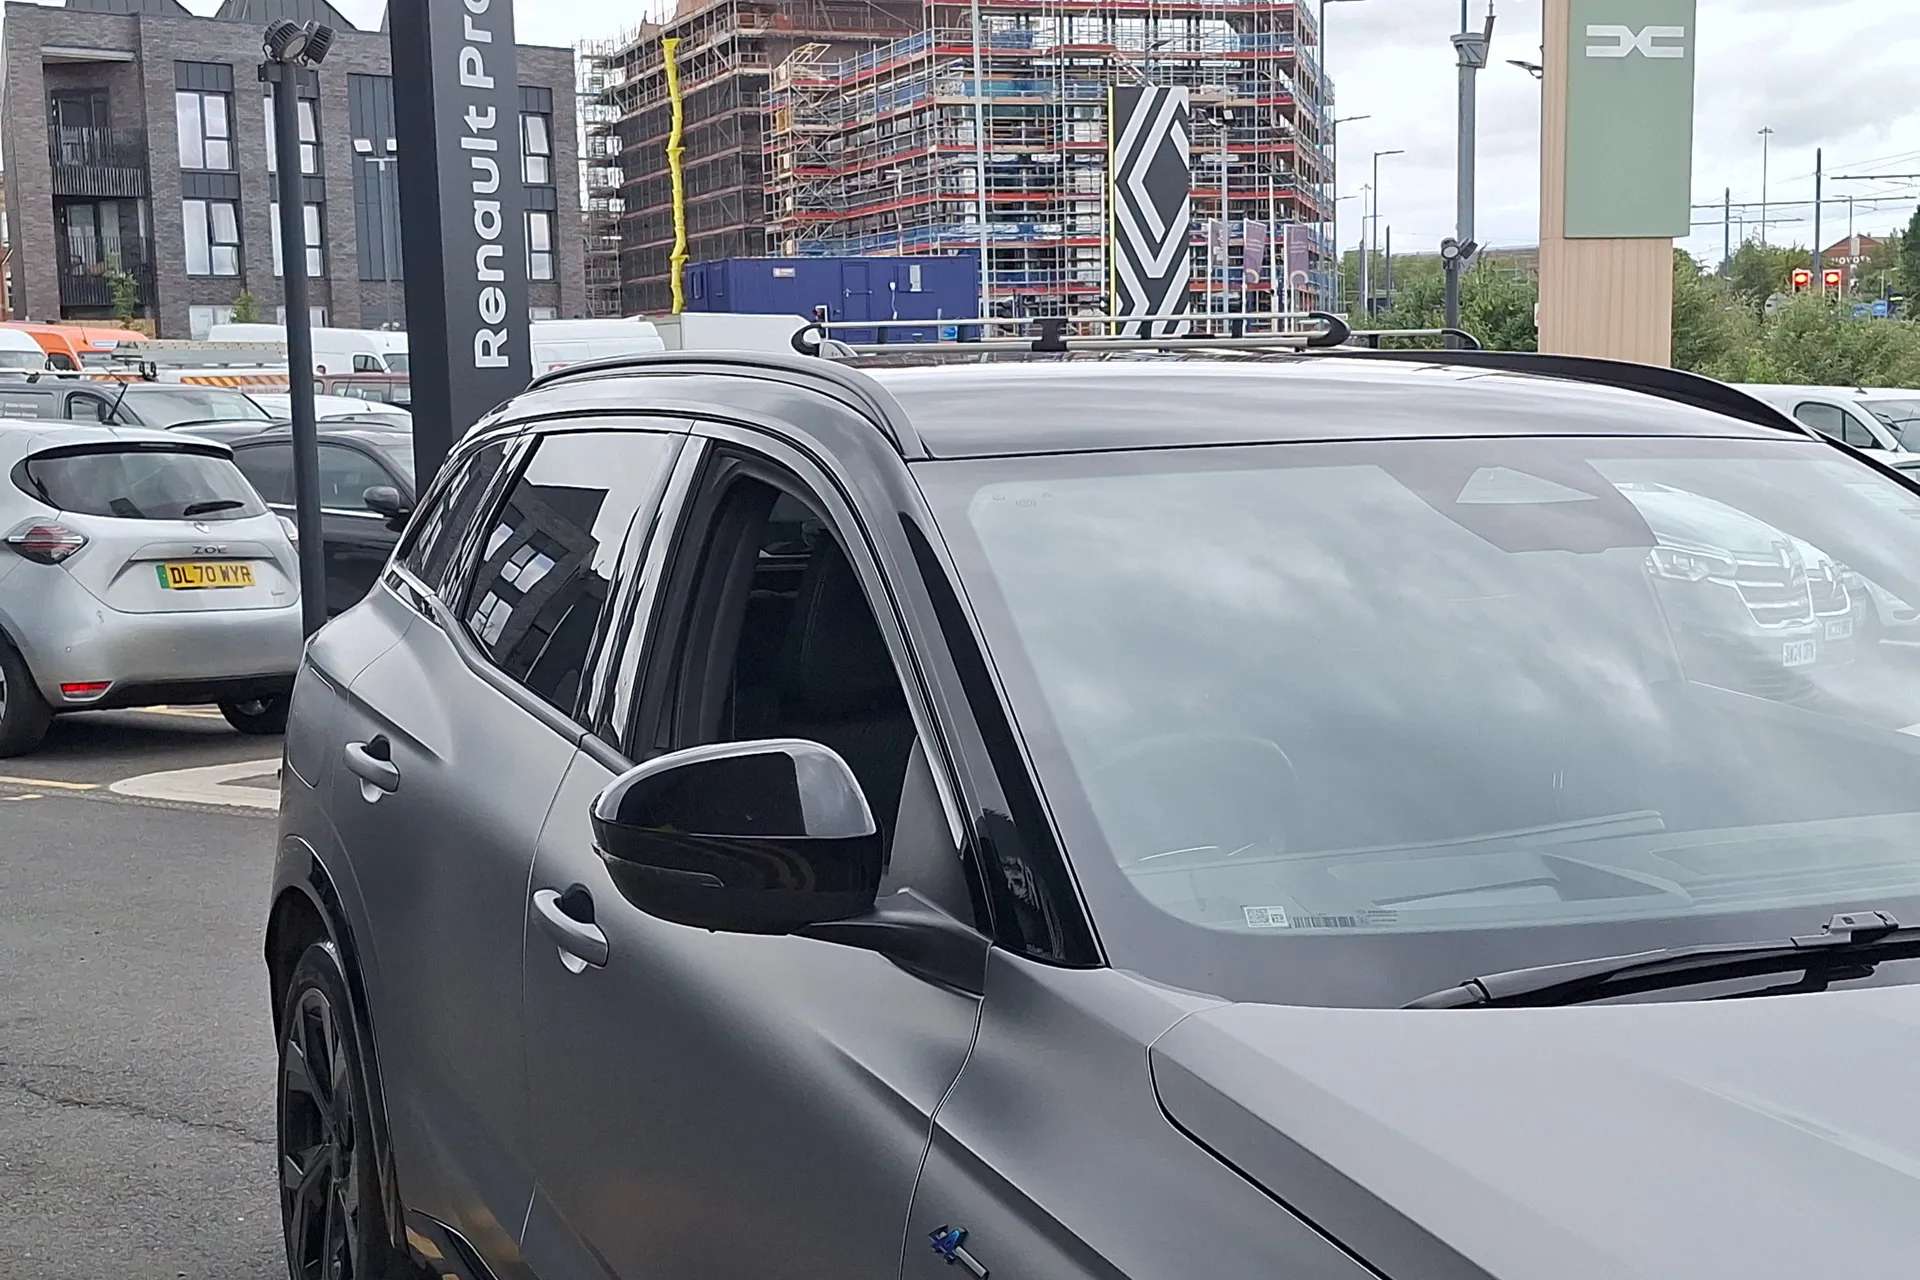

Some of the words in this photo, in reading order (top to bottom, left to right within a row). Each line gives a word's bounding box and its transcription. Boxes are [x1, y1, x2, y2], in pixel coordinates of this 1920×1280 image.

[460, 105, 509, 368] Renault
[169, 565, 217, 584] DL70
[219, 564, 252, 583] WYR
